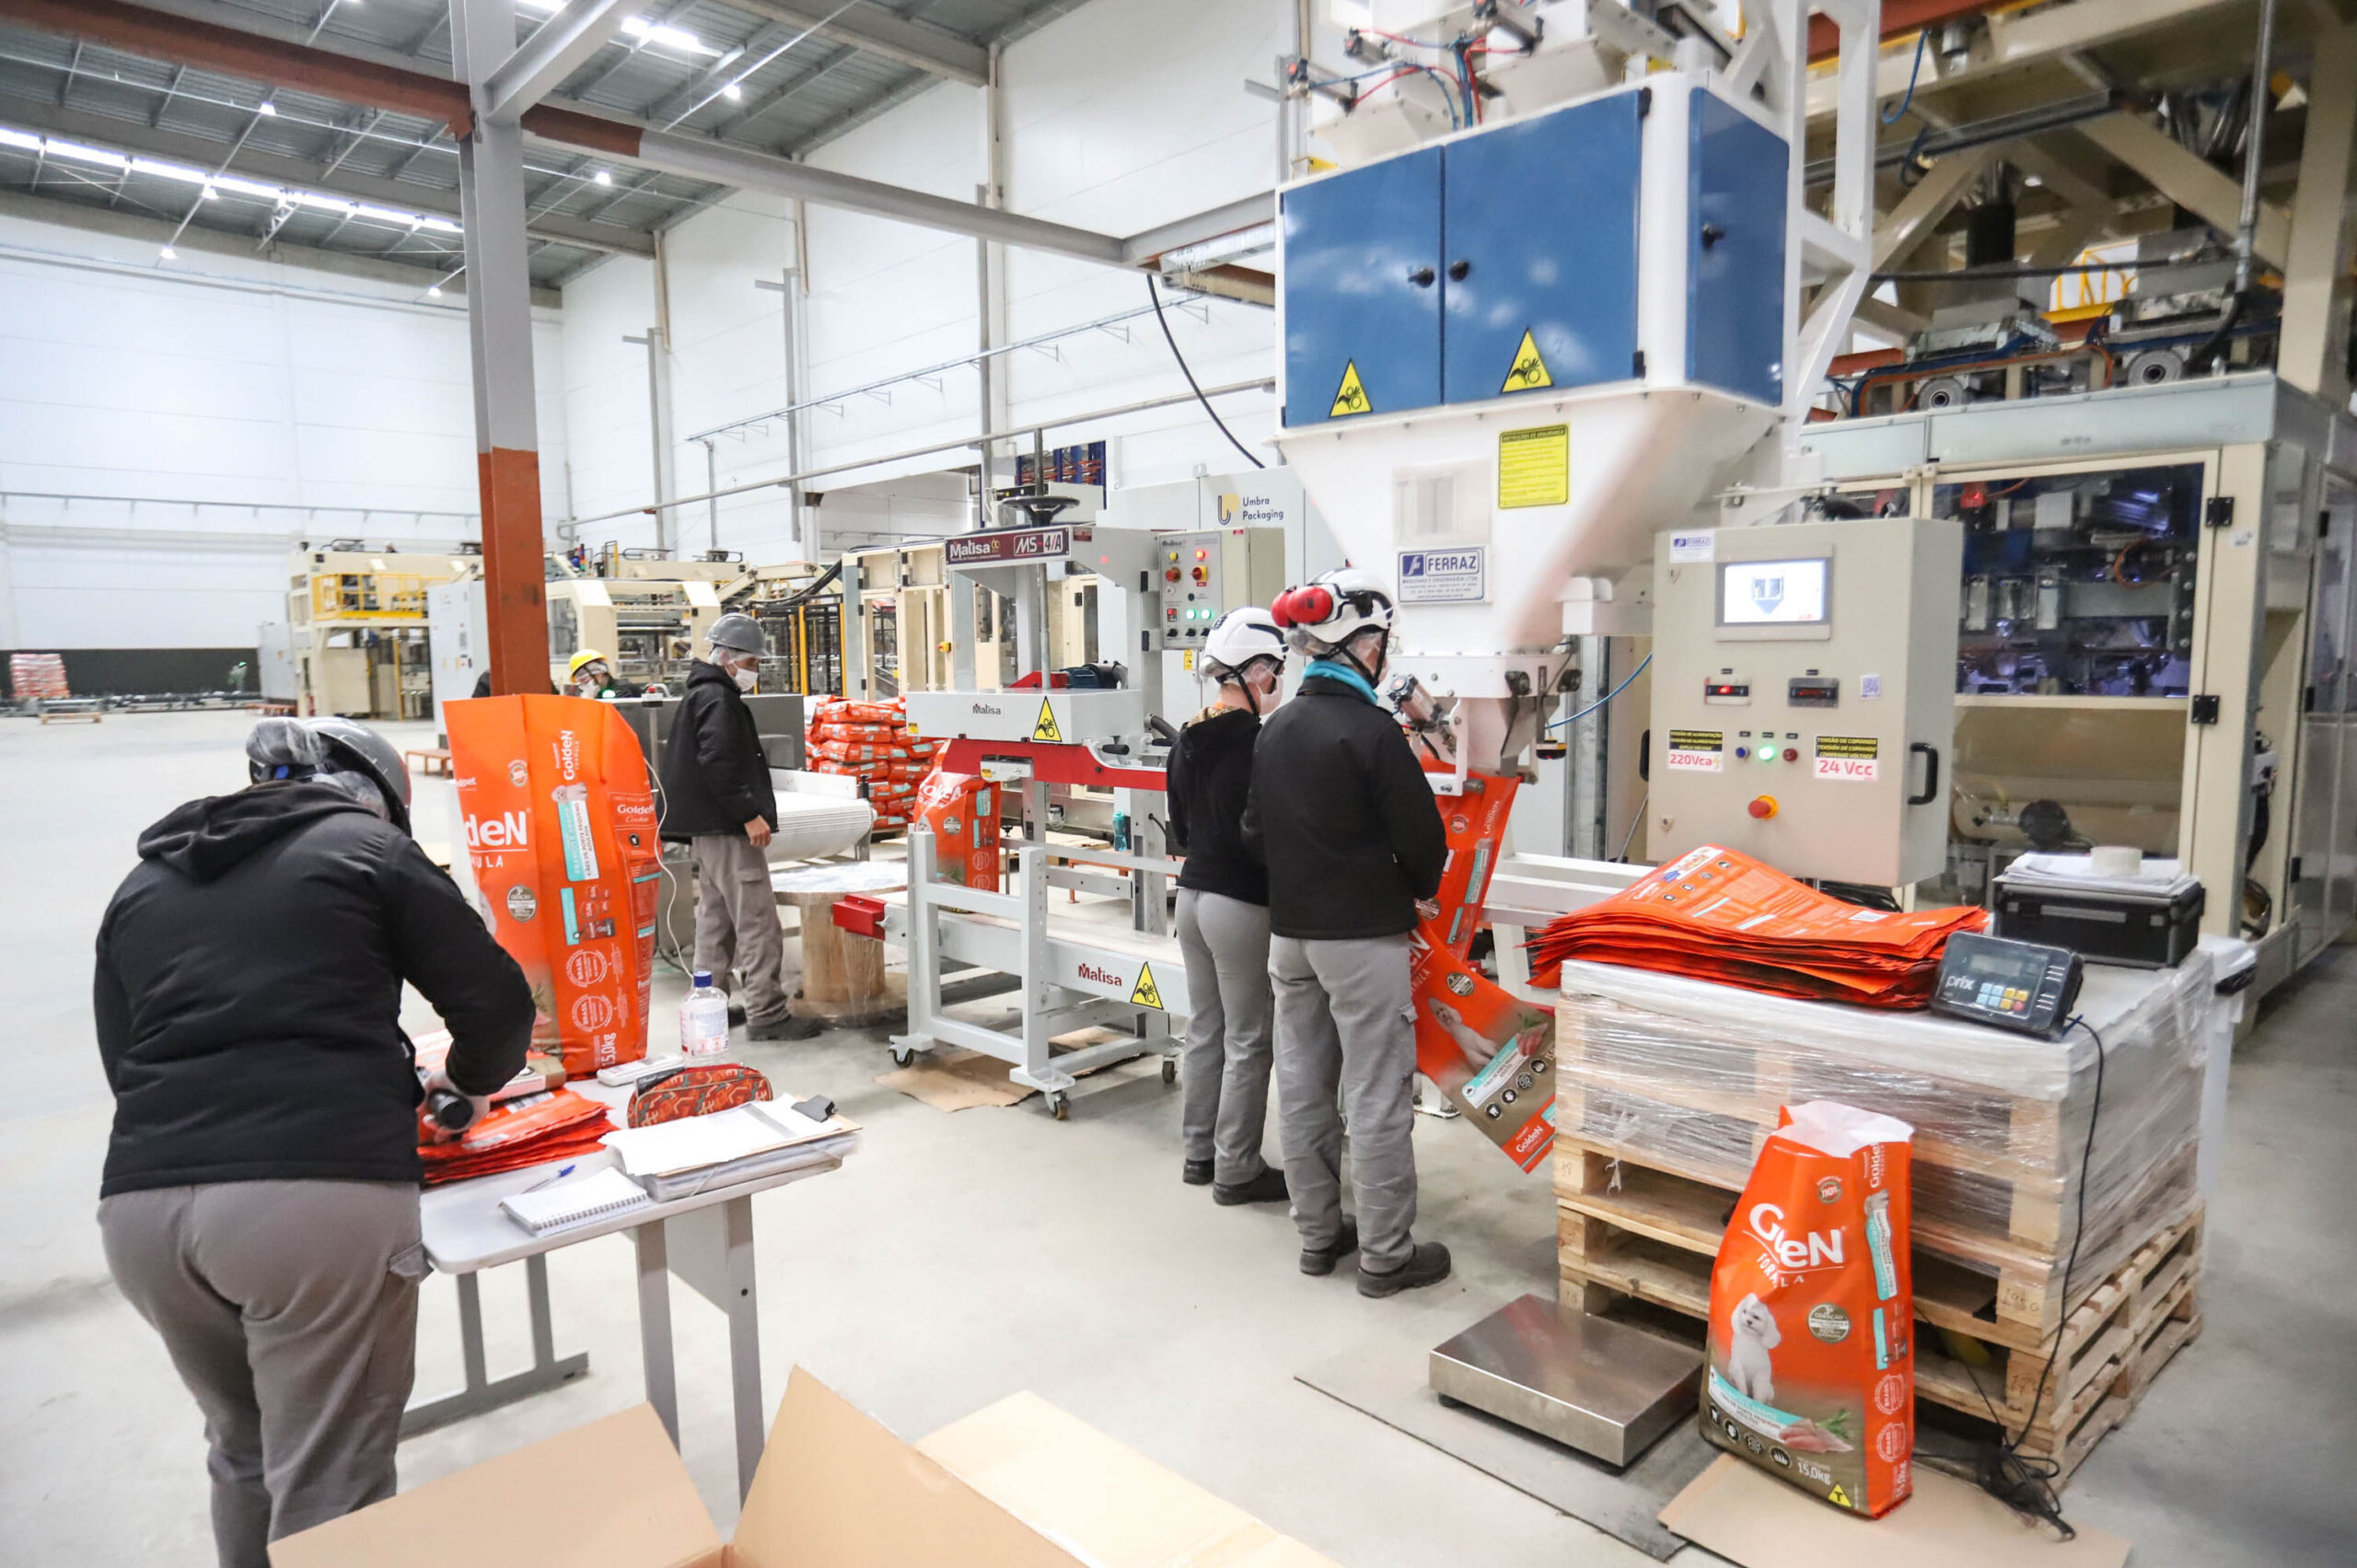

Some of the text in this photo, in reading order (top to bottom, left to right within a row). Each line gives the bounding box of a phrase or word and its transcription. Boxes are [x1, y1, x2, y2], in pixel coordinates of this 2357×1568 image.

[1243, 495, 1270, 506] Umbra
[1243, 509, 1283, 521] Packaging
[1428, 555, 1477, 572] FERRAZ
[561, 729, 575, 781] GoldeN
[1670, 753, 1713, 766] 220Vca
[1819, 760, 1873, 775] 24 Vcc
[1945, 975, 1976, 991] prix
[1797, 1461, 1831, 1485] 15,0kg
[1834, 1491, 1843, 1502] T
